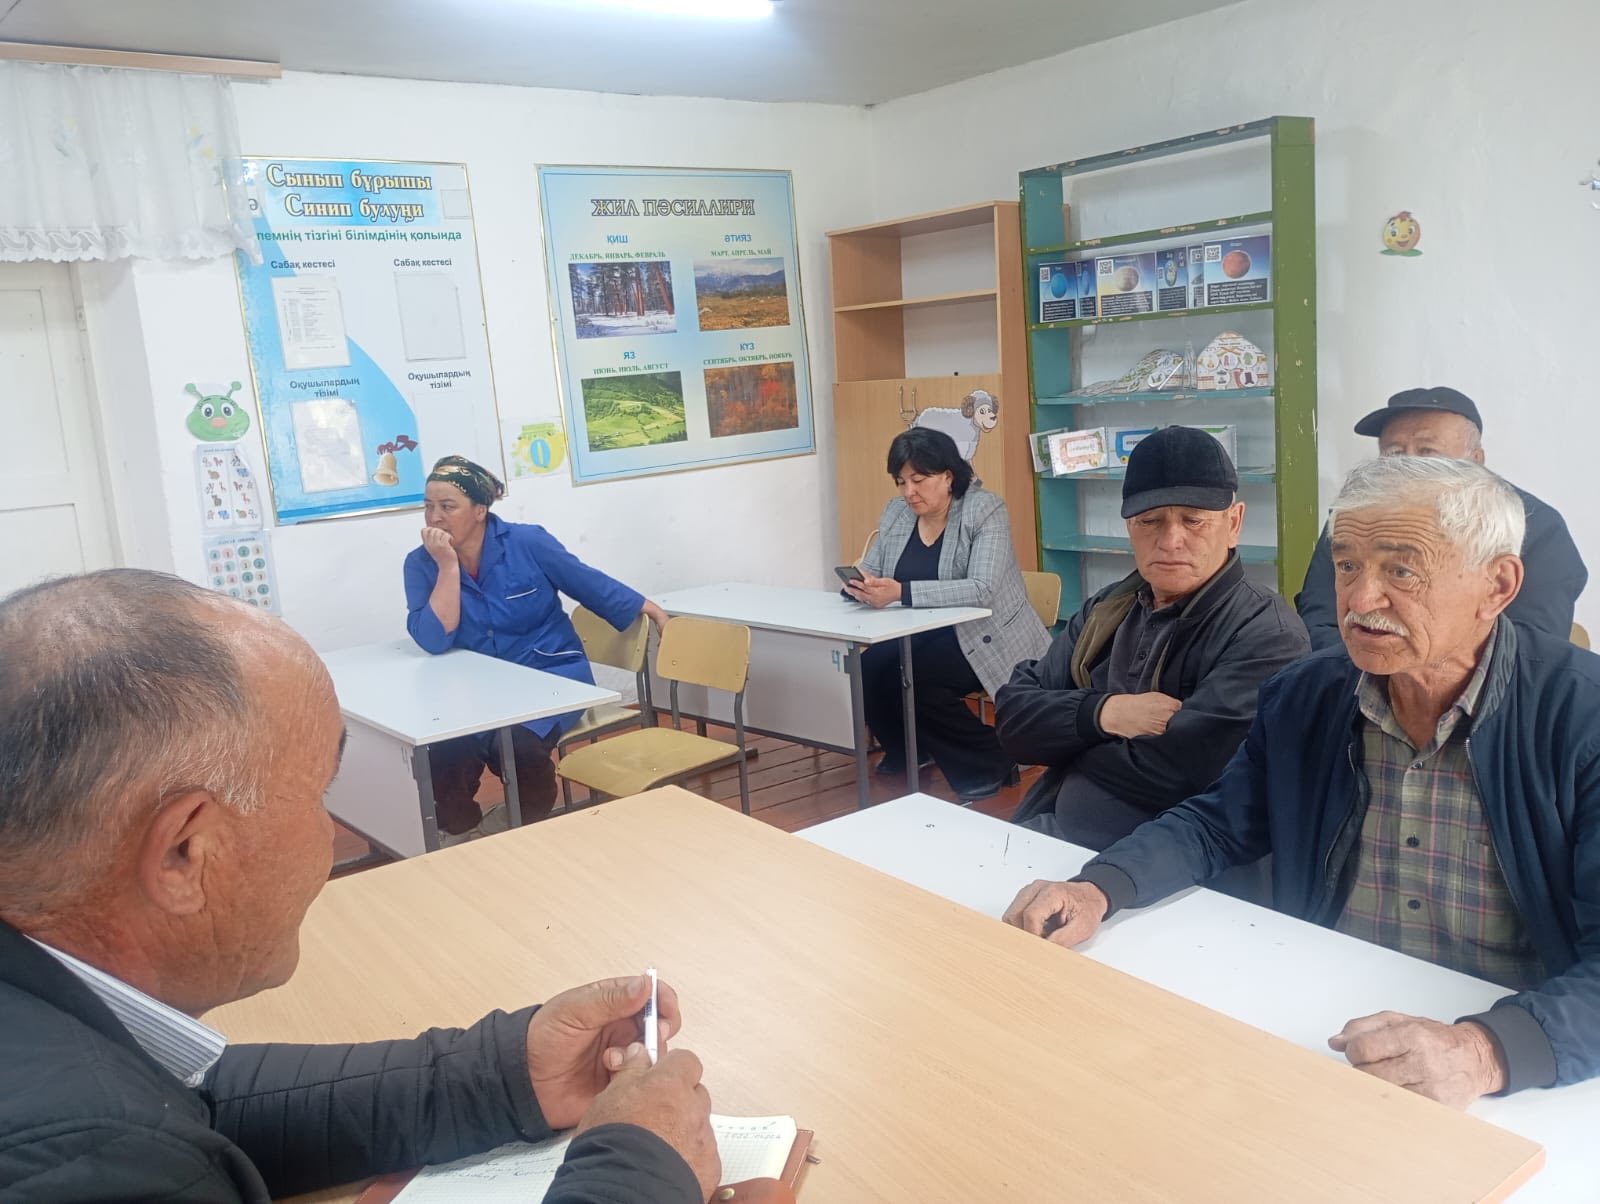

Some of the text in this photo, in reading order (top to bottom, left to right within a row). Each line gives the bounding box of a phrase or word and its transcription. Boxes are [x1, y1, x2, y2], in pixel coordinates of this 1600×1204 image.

[266, 164, 432, 194] Сынып бұрышы
[285, 193, 424, 223] Синип булуңи
[590, 199, 756, 216] ЖИЛ ПӘСИЛЛИРИ
[304, 229, 342, 241] тізгіні
[345, 229, 408, 242] білімдінің
[410, 230, 462, 242] қолында
[607, 234, 629, 245] ҚИШ
[635, 251, 666, 259] ФЕВРАЛЬ
[270, 259, 336, 270] Сабақ кестесі
[393, 257, 453, 267] Сабақ кестесі
[623, 351, 636, 360] ЯЗ
[643, 363, 669, 371] АВГУСТ
[407, 370, 472, 381] Оқушылардың
[289, 378, 361, 390] Оқушылардың
[430, 380, 452, 389] тізімі
[314, 388, 339, 398] тізімі
